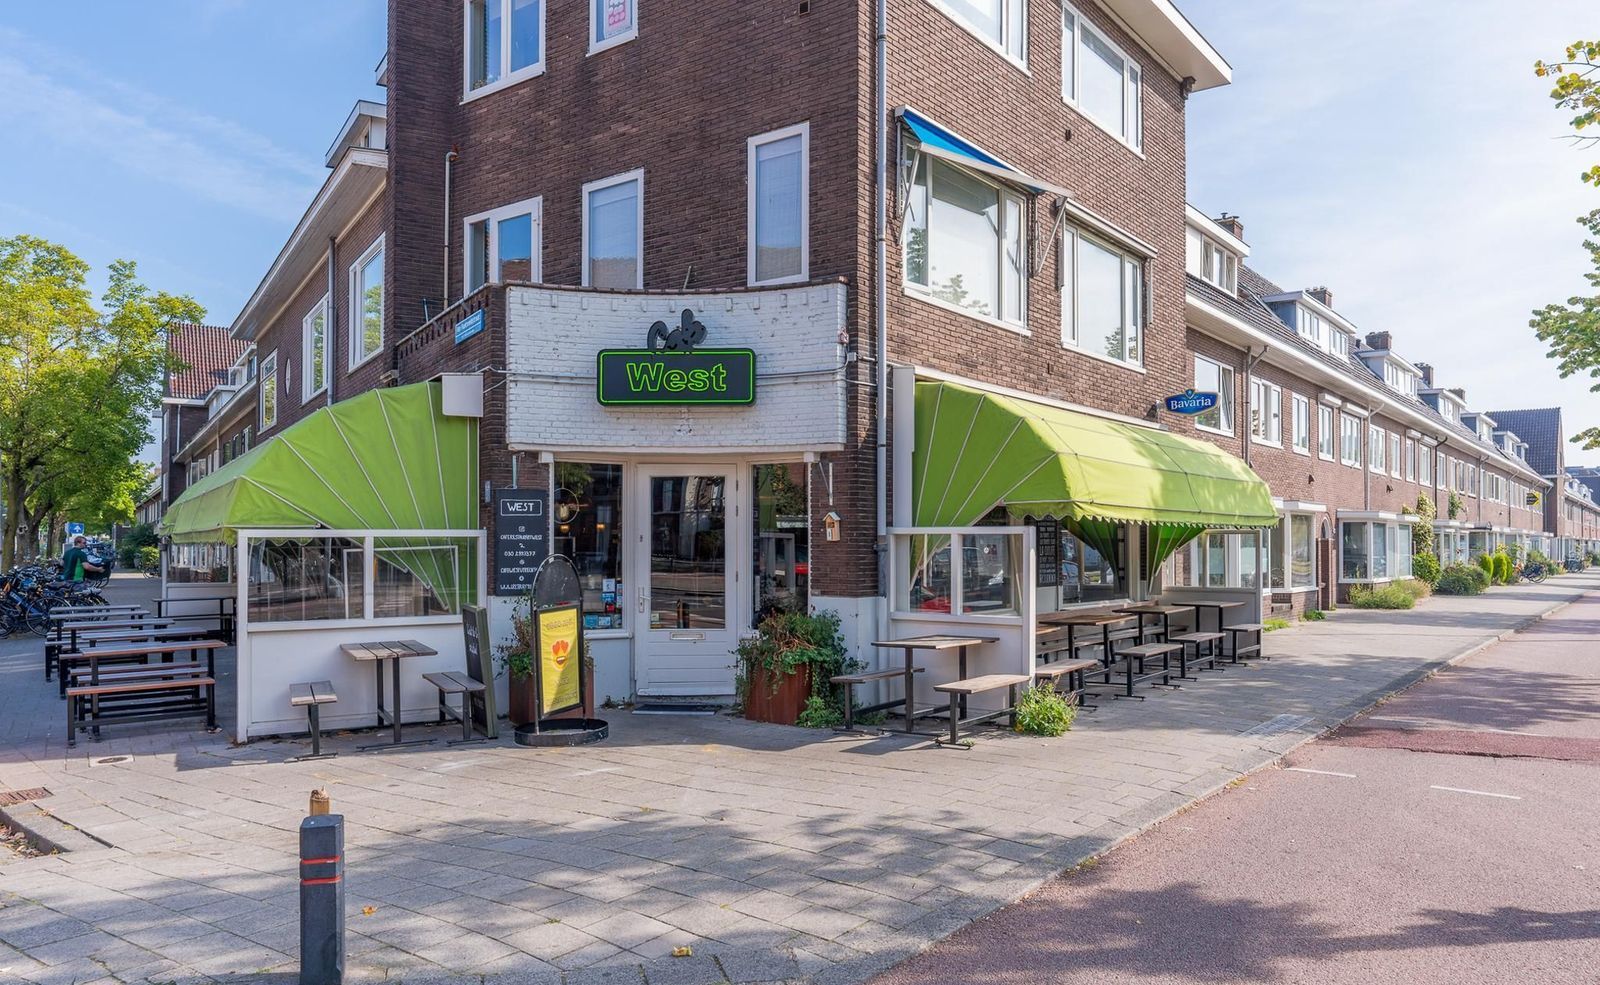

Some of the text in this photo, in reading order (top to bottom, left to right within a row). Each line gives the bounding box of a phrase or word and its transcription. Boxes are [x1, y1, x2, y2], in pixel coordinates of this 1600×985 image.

[625, 362, 727, 392] West
[1170, 397, 1212, 410] Bavaria
[506, 502, 534, 512] WEST
